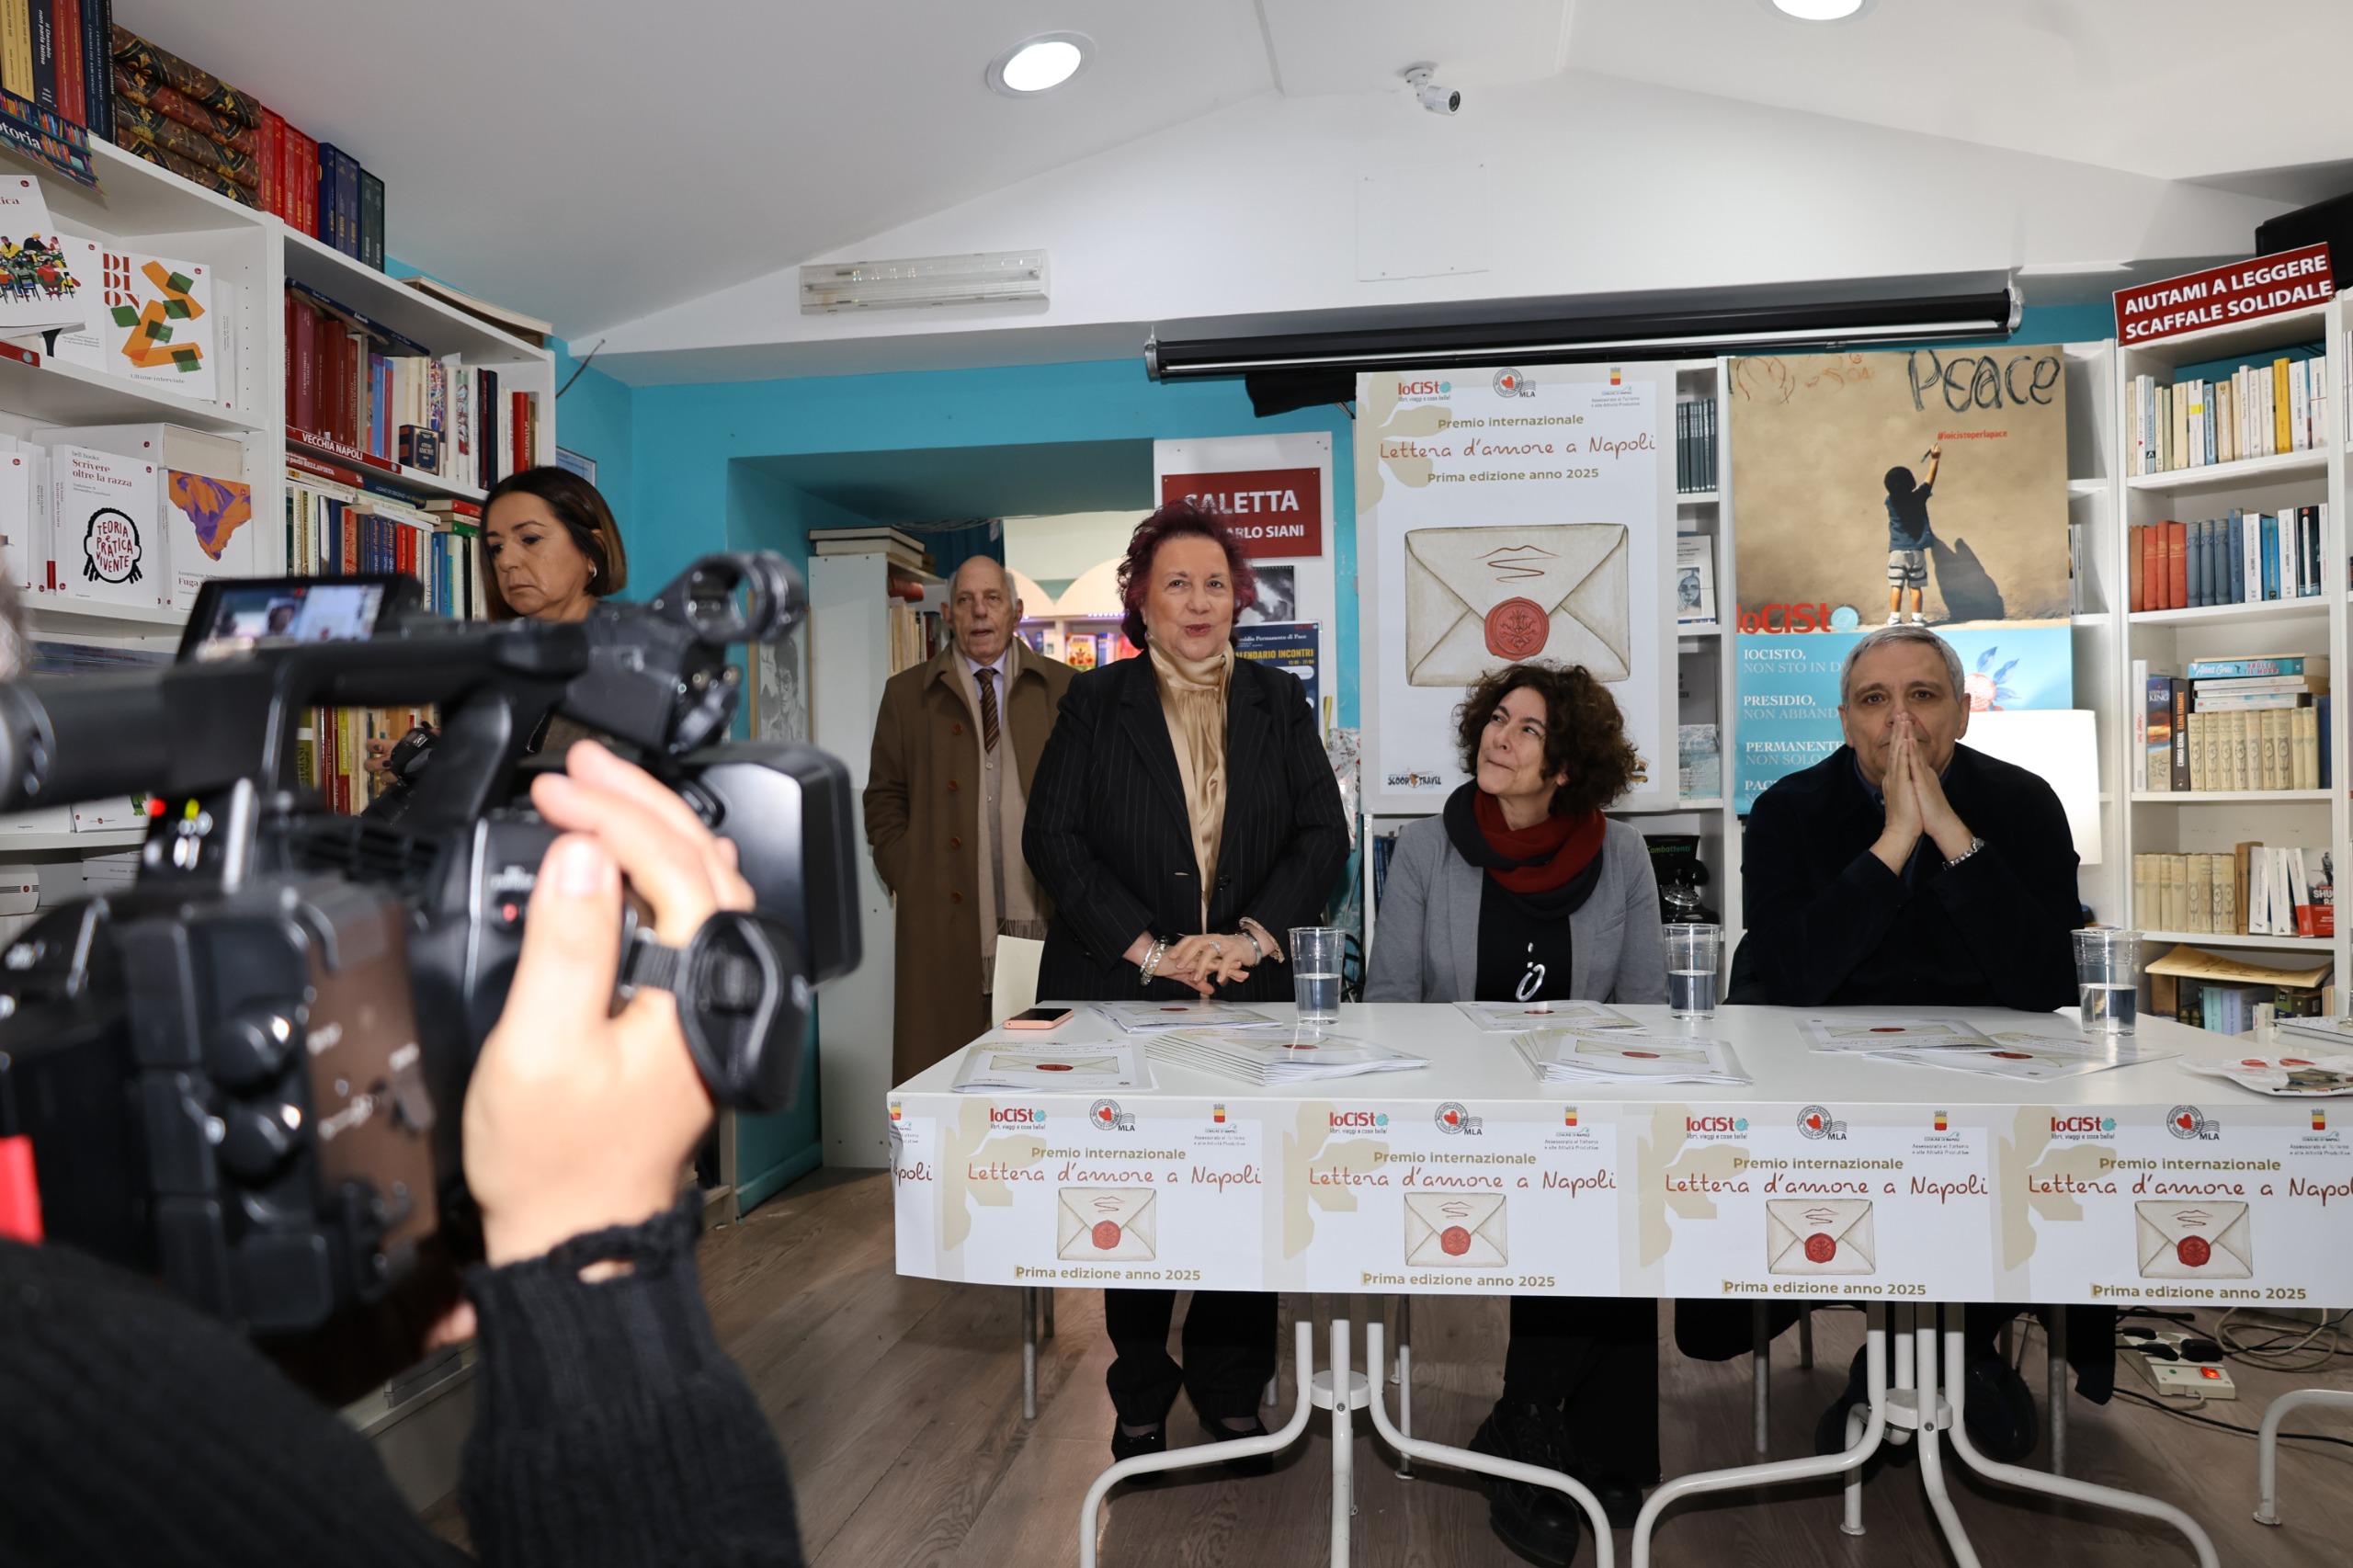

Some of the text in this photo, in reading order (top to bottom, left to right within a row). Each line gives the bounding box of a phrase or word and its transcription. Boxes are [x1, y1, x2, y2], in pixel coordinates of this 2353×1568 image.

[0, 120, 42, 151] toria
[103, 253, 131, 273] DI
[103, 271, 131, 291] DI
[2125, 254, 2327, 315] AIUTAMI A LEGGERE
[2125, 279, 2334, 341] SCAFFALE SOLIDALE
[130, 373, 186, 384] Ultime interviste
[1438, 415, 1585, 429] Premio internazionale
[302, 432, 363, 461] VECCHIA NAPOLI
[1380, 432, 1655, 460] Lettera d'amore a Napoli
[73, 460, 110, 472] Scrivere
[303, 460, 335, 476] BELLAVISTA
[73, 470, 132, 487] oltre la razza
[1427, 468, 1599, 483] Prima edizione anno 2025
[1184, 489, 1300, 515] SALETTA
[97, 520, 129, 538] TEORIA
[1266, 524, 1304, 538] SIANI
[96, 537, 134, 558] PRATICA
[96, 551, 130, 573] VIVENTE
[178, 577, 199, 587] Fuga
[1235, 649, 1314, 660] ALENDARIO INCONTRI
[1745, 649, 1807, 661] IOCISTO,
[1745, 663, 1775, 674] NON
[1778, 662, 1807, 673] STO
[1811, 662, 1826, 673] IN
[2196, 665, 2216, 676] Anna
[1744, 695, 1816, 707] PRESIDIO,
[1745, 708, 1839, 720] NON ABBAND
[2177, 715, 2185, 730] ELENA
[1746, 755, 1822, 766] NON SOLO
[1388, 776, 1442, 786] SCOOP TRAVEL
[1745, 780, 1777, 790] PAC
[2313, 890, 2334, 899] SHU
[2200, 1132, 2220, 1141] MLA
[1031, 1147, 1187, 1161] Premio internazionale
[1373, 1152, 1537, 1165] Premio internazionale
[1733, 1157, 1904, 1171] Premio internazionale
[2099, 1157, 2281, 1171] Premio internazionale
[968, 1162, 1262, 1193] Lettera d'amore a Napoli
[1310, 1166, 1617, 1199] Lettera d'amore a Napoli
[1665, 1173, 1988, 1205] Lettera d'amore a Napoli
[2029, 1173, 2353, 1207] Lettera d'amore a Napo
[1016, 1267, 1201, 1280] Prima edizione anno 2025
[1363, 1273, 1555, 1288] Prima edizione anno 2025
[1724, 1281, 1927, 1296] Prima edizione anno 2025
[2093, 1285, 2306, 1300] Prima edizione anno 2025
